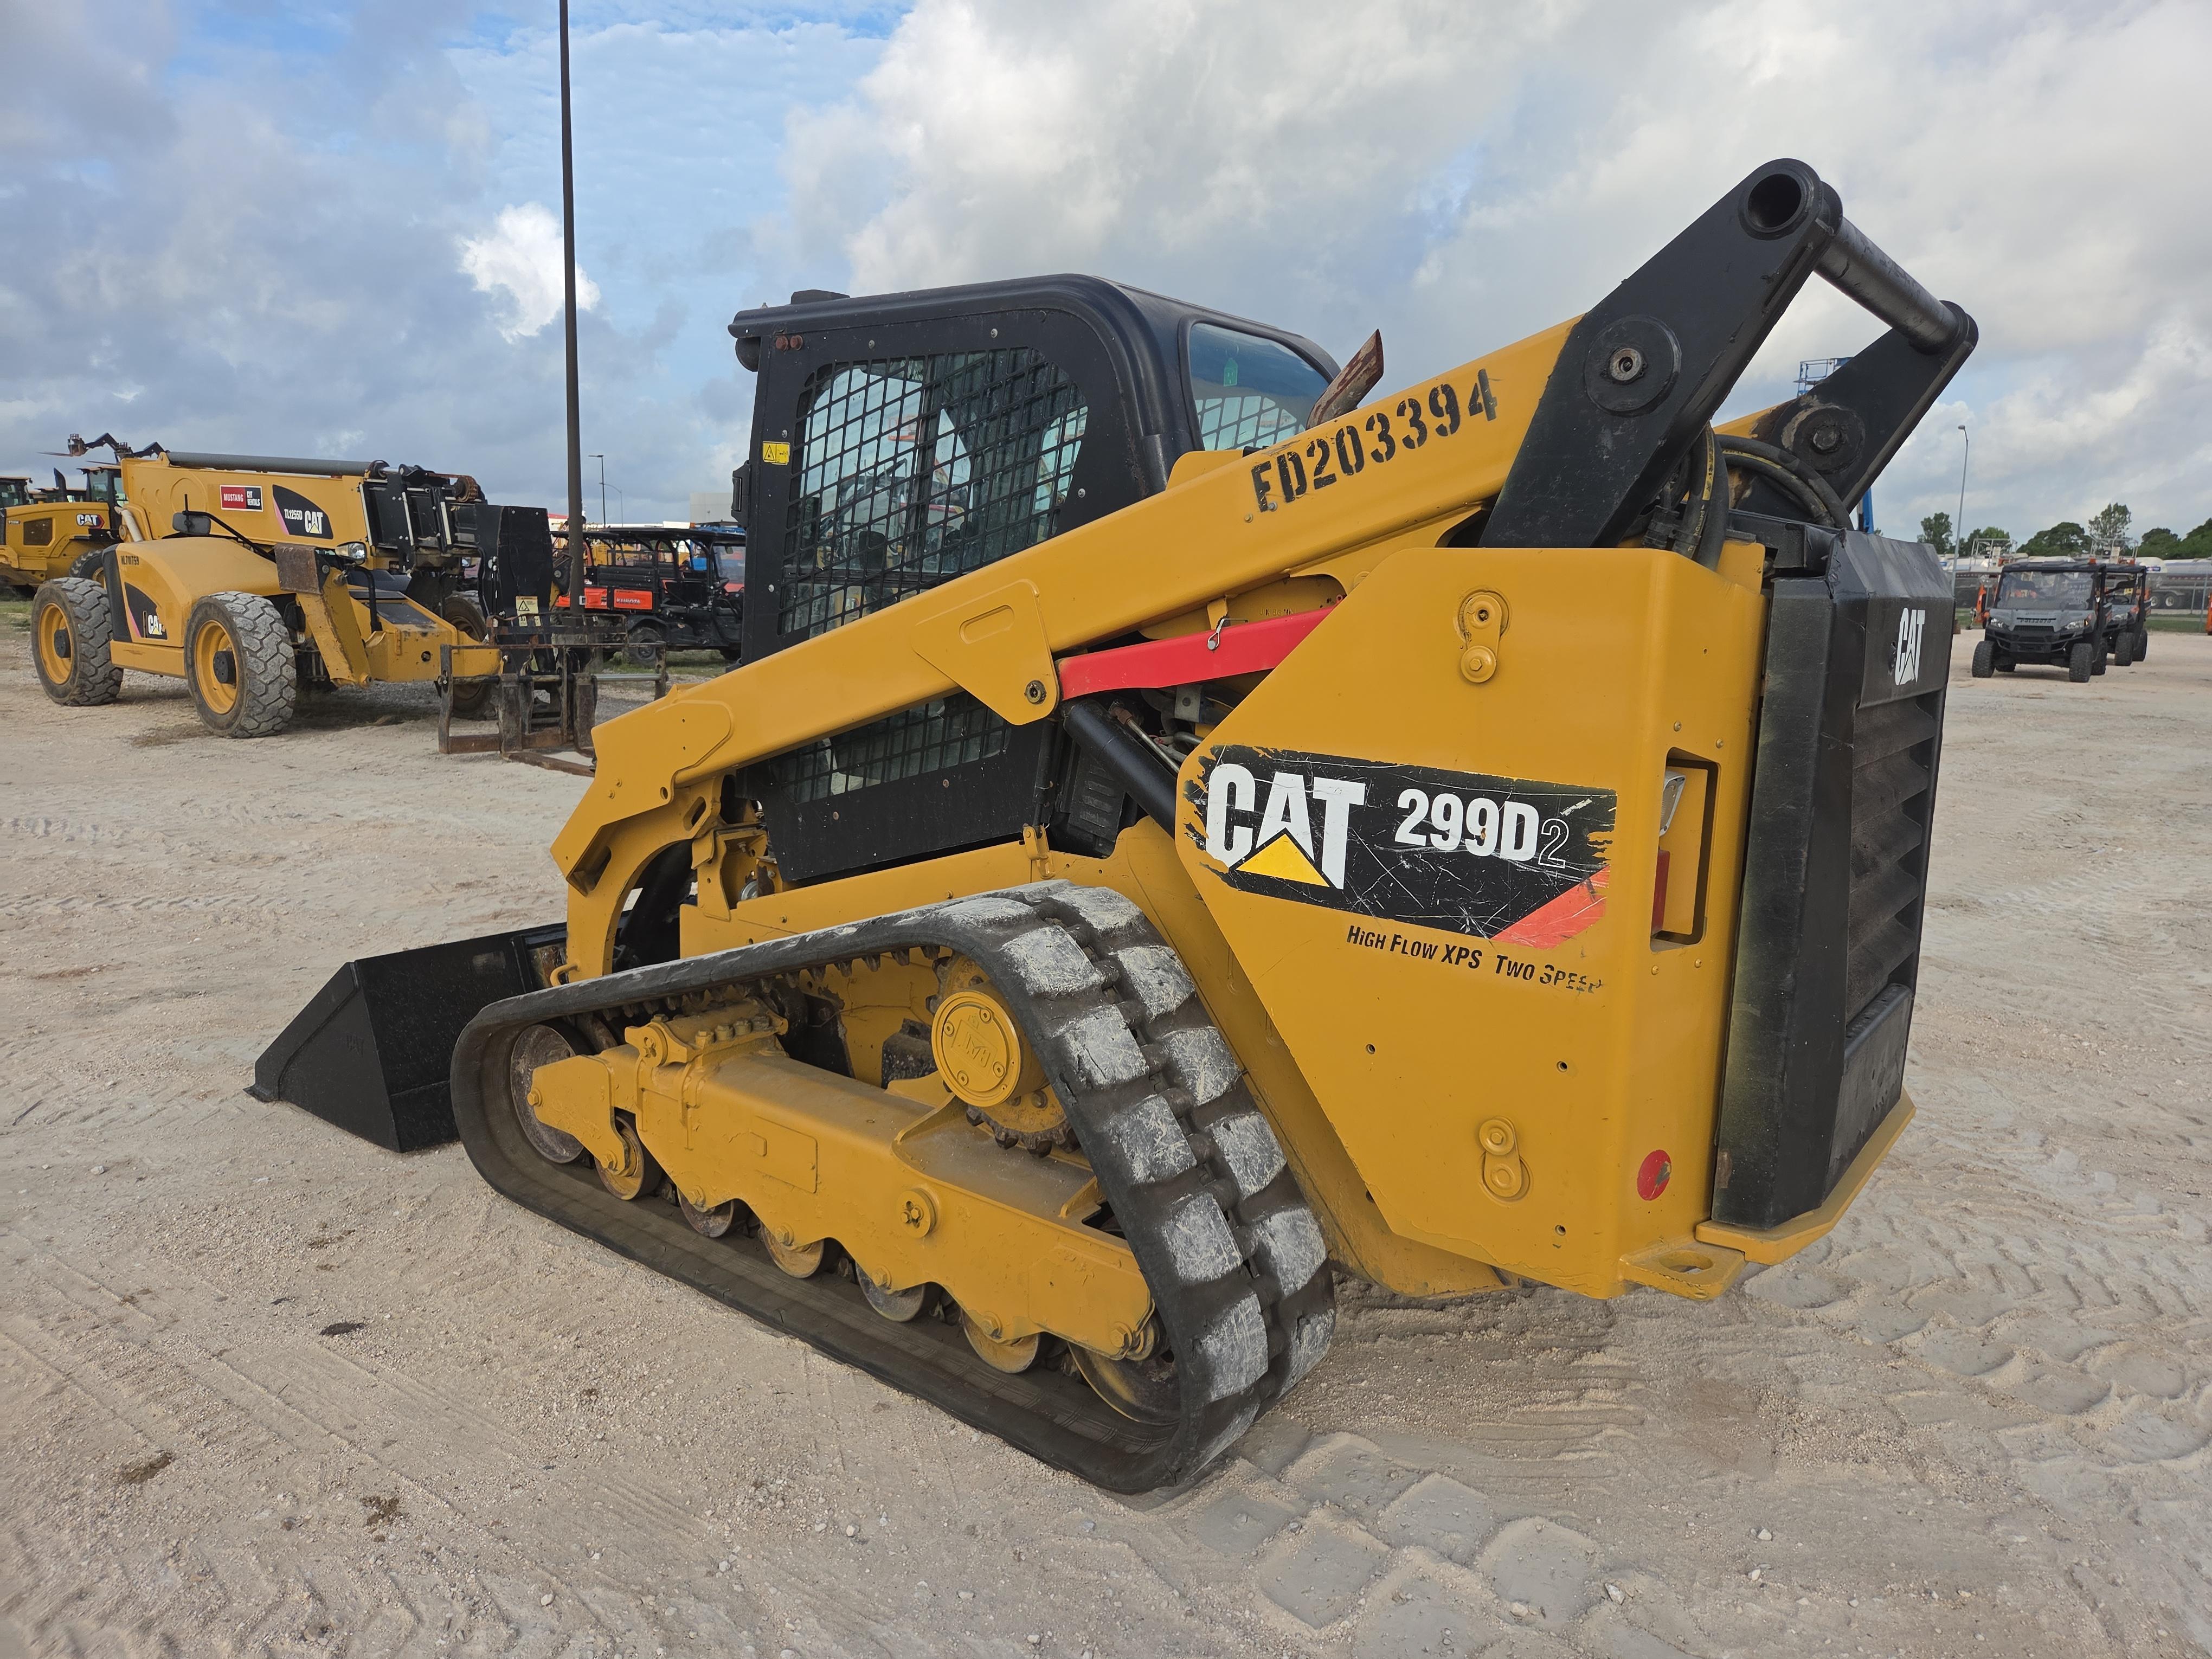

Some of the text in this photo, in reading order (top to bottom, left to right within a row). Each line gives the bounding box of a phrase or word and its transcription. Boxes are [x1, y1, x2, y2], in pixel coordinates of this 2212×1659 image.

[1251, 369, 1497, 512] FD203394
[77, 515, 98, 526] CAT
[284, 509, 323, 534] TL1255D CAT
[1895, 607, 1926, 685] CAT
[1206, 763, 1366, 890] CAT
[1441, 944, 1482, 969] XPS
